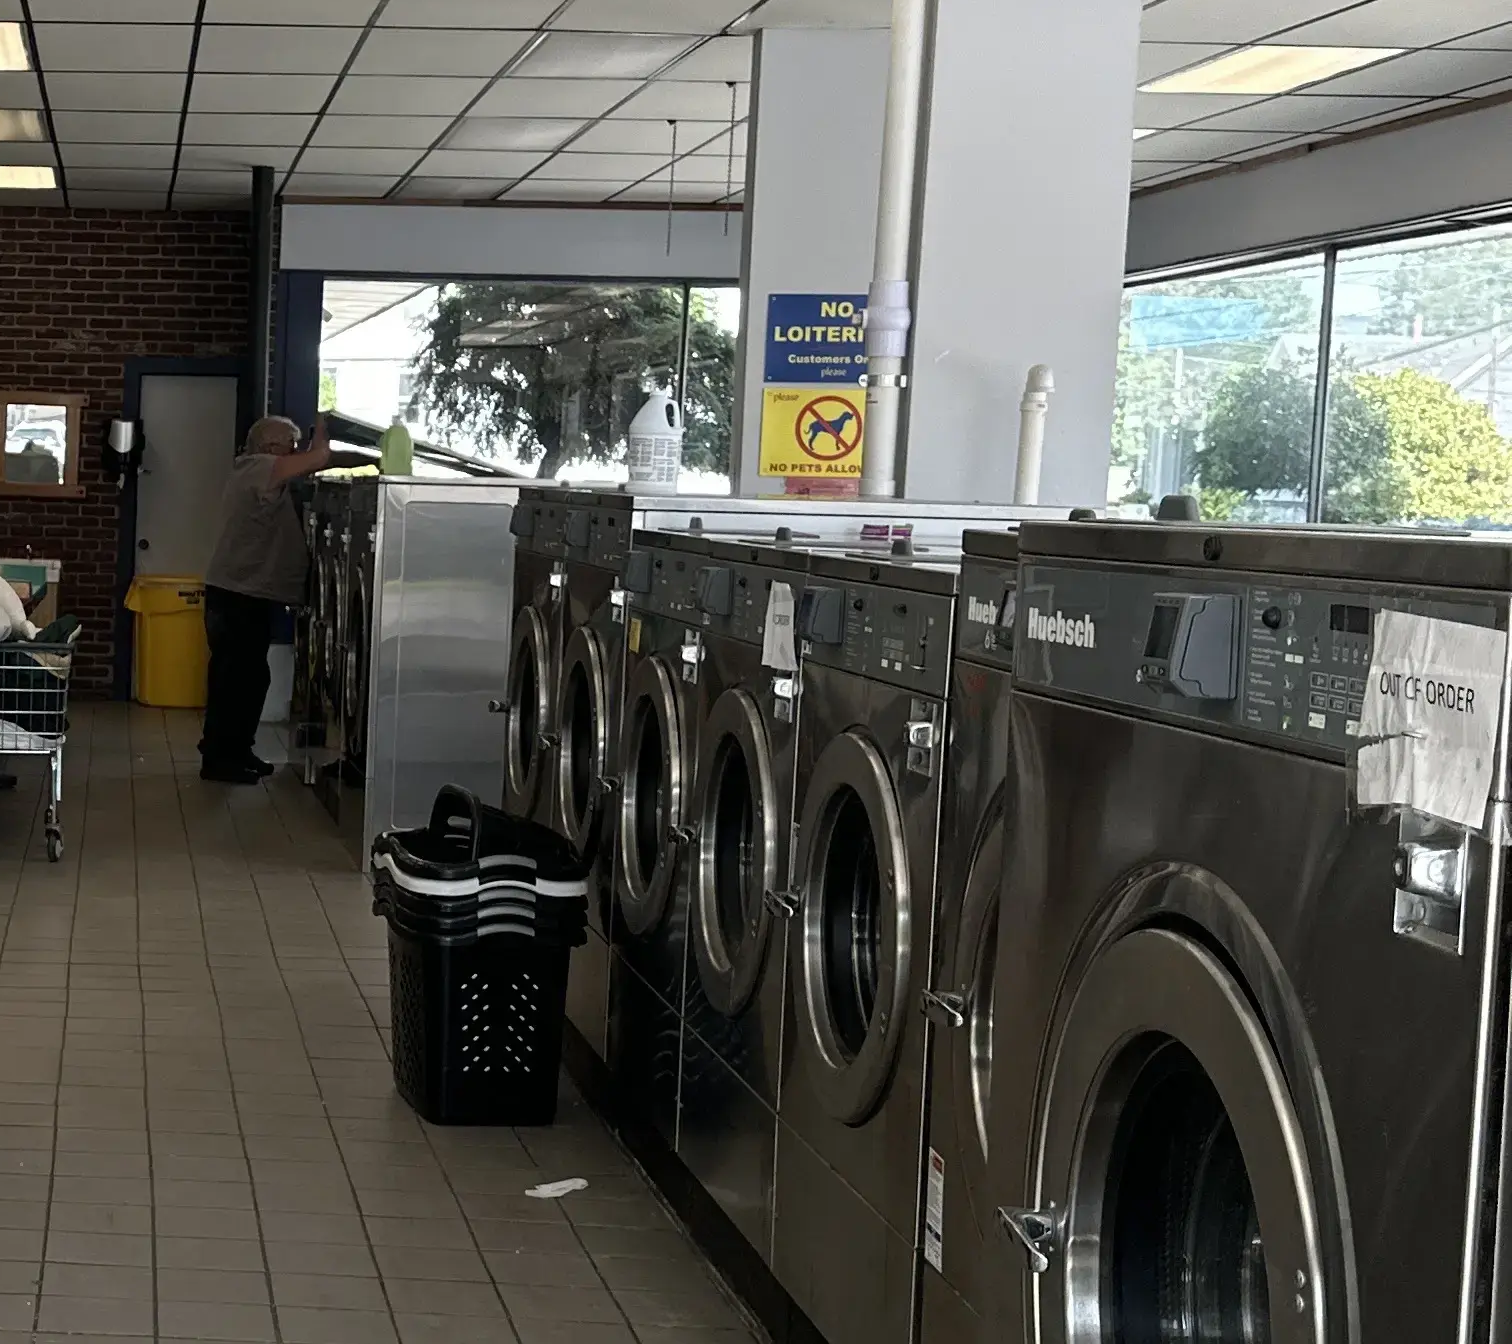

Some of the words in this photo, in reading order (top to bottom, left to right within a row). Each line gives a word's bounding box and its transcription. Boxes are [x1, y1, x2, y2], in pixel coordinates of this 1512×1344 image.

[820, 302, 853, 318] NO
[774, 326, 863, 343] LOITERI
[788, 354, 851, 364] Customers
[820, 367, 847, 378] please
[773, 392, 800, 403] please
[769, 463, 787, 472] NO
[791, 463, 821, 473] PETS
[825, 463, 862, 474] ALLO
[968, 596, 997, 626] Hueb
[1028, 607, 1096, 649] Huebsch
[1380, 671, 1401, 697] OUT
[1426, 680, 1475, 714] ORDER
